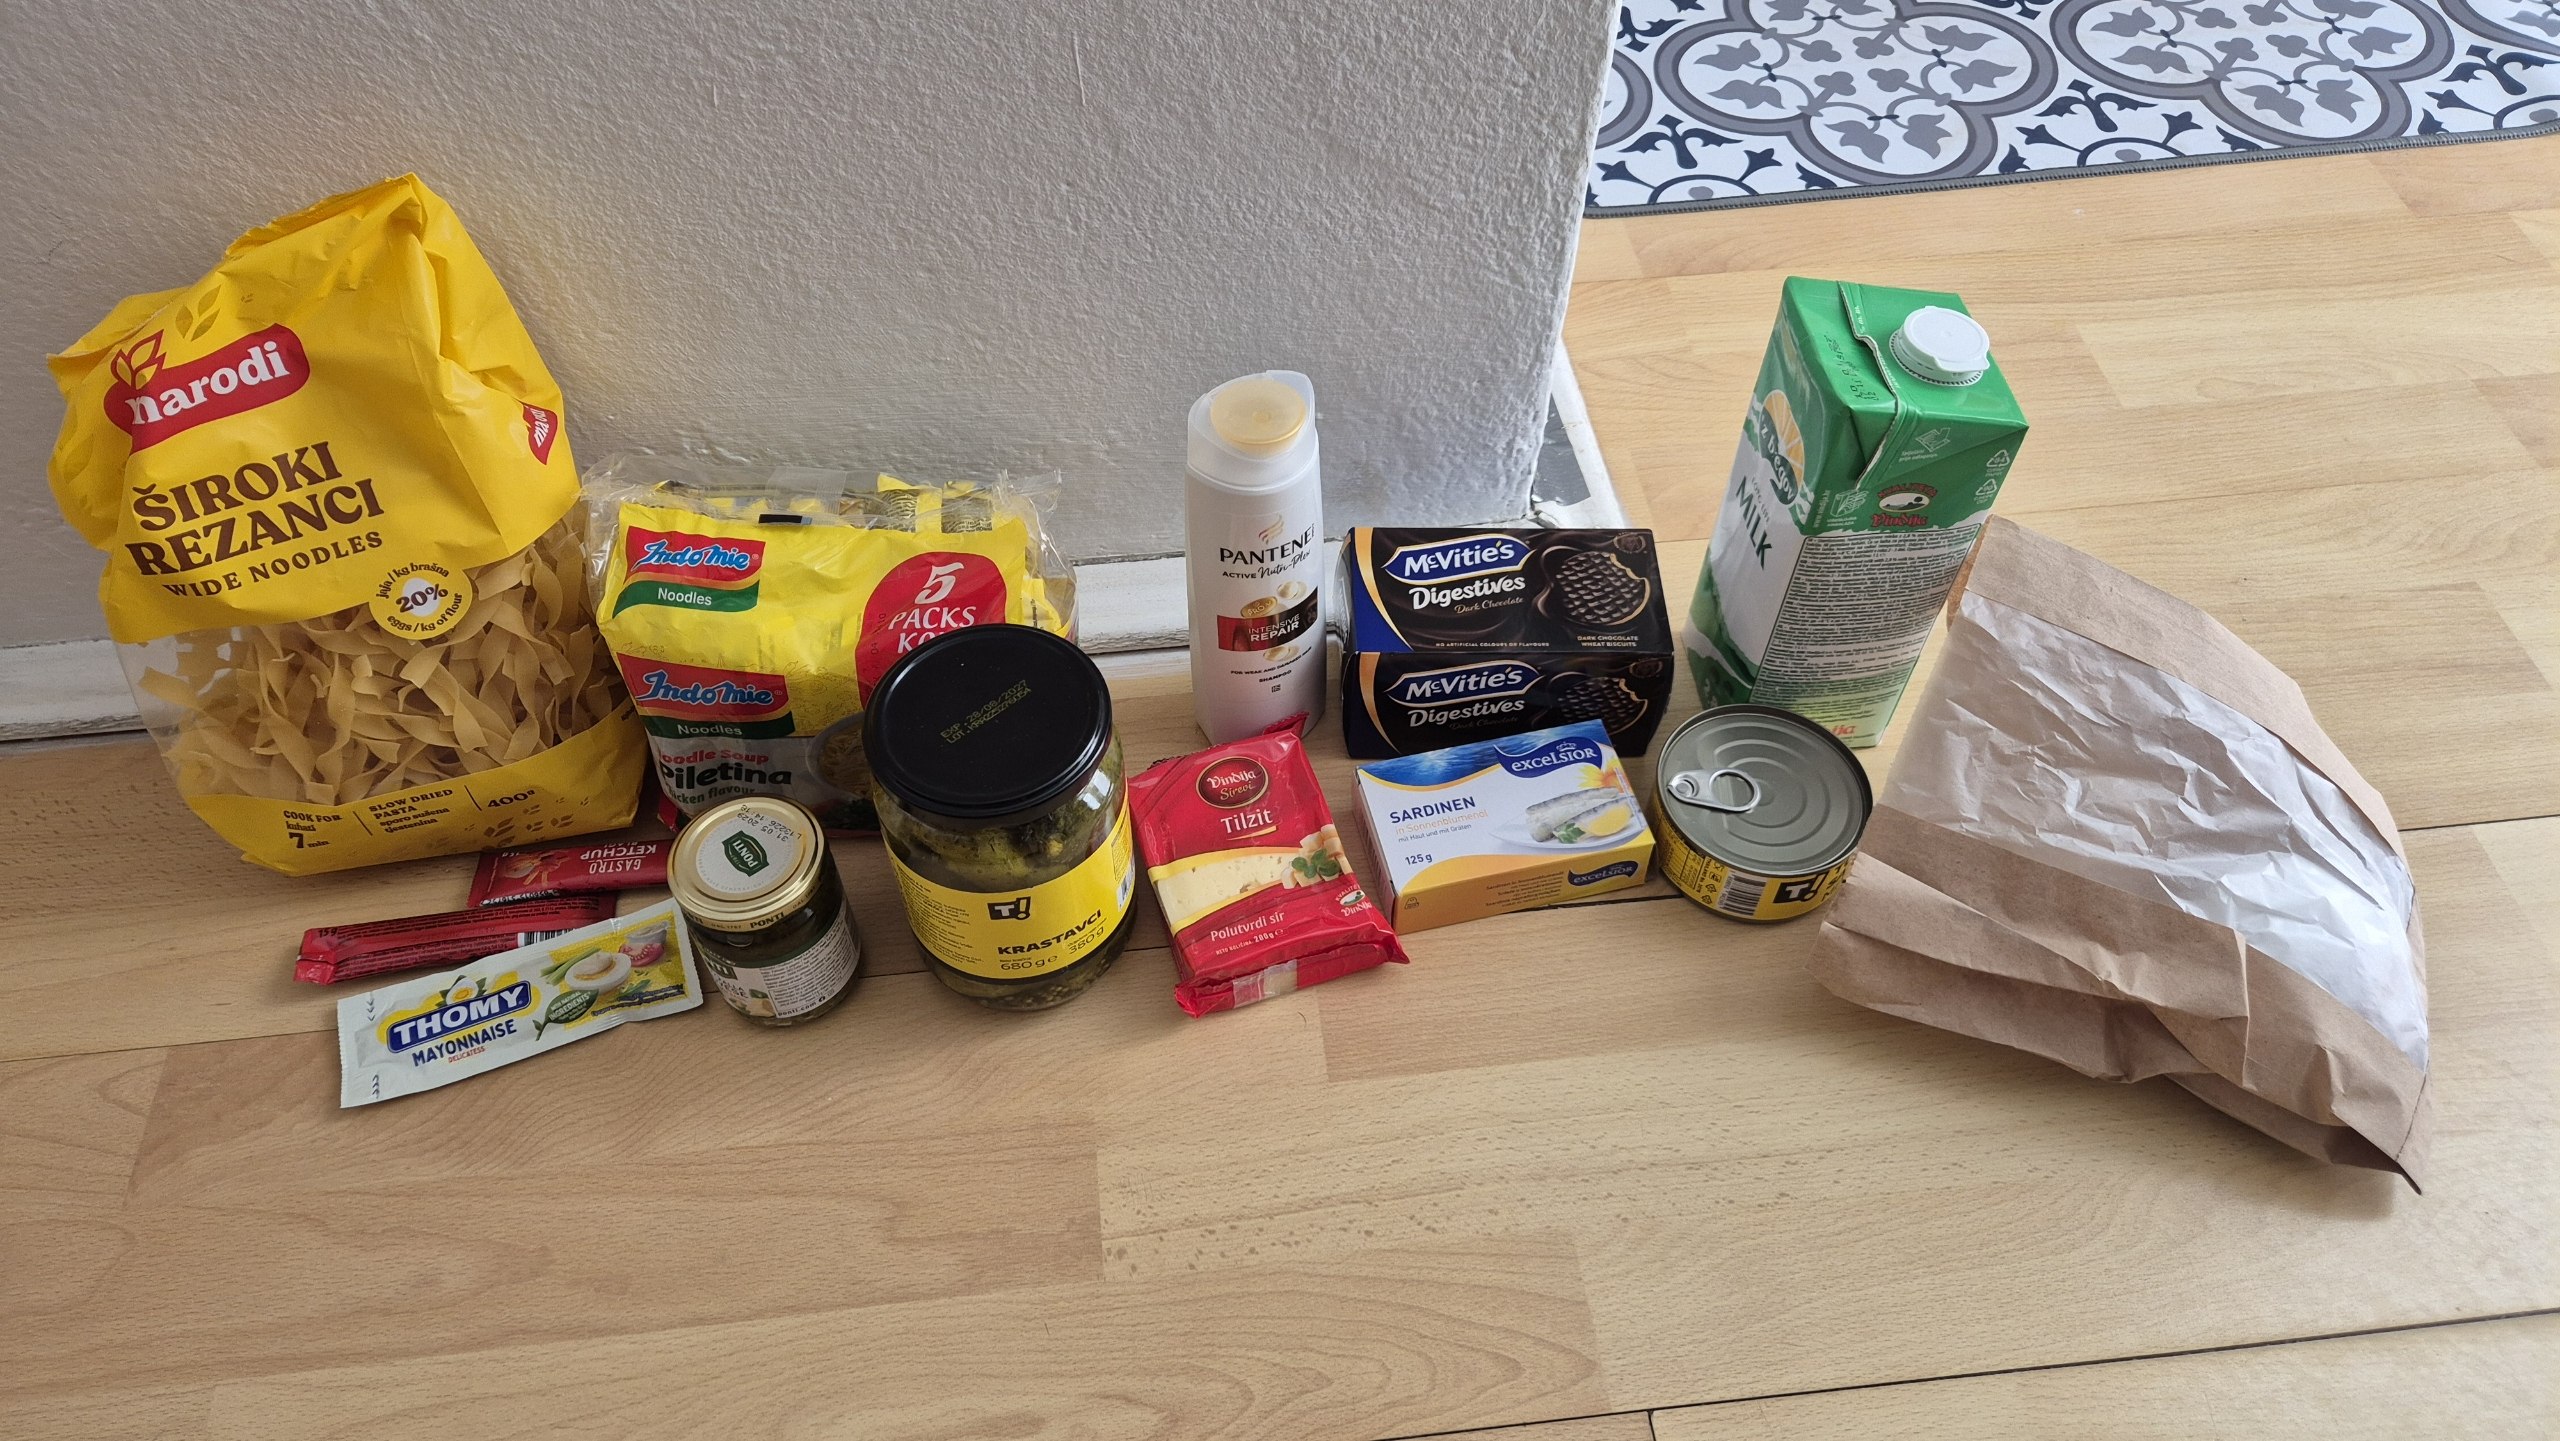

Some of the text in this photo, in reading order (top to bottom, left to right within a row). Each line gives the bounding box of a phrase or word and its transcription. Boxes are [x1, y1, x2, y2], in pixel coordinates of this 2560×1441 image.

[125, 341, 290, 425] narodi
[132, 441, 342, 532] ŠIROKI
[125, 478, 384, 575] REZANCI
[1736, 475, 1772, 571] MILK
[1219, 525, 1312, 565] PANTENE
[164, 530, 384, 597] WIDE NOODLES
[1404, 541, 1516, 577] McVitie's
[376, 580, 393, 599] jaja
[393, 567, 410, 579] kg
[410, 562, 450, 578] brašna
[914, 562, 965, 605] 5
[1222, 571, 1256, 579] ACTIVE
[395, 583, 449, 613] 20%
[657, 587, 713, 606] Noodles
[1408, 575, 1526, 610] Digestives
[387, 615, 412, 631] eggs
[421, 623, 436, 632] kg
[437, 614, 448, 626] of
[445, 593, 462, 617] flour
[1454, 596, 1526, 614] Dark Chocolate
[888, 606, 977, 630] PACKS
[1248, 613, 1300, 634] INTENSIVE
[1250, 621, 1300, 642] REPAIR
[1259, 669, 1292, 683] SHAMPOO
[1406, 667, 1524, 701] McVitie's
[1407, 698, 1525, 727] Digestives
[677, 723, 743, 737] Noodles
[720, 750, 769, 765] Soup
[369, 789, 454, 812] SLOW DRIED
[1220, 784, 1254, 801] Sirevi
[283, 810, 343, 823] COOK FOR
[373, 805, 418, 819] PASTA
[380, 806, 451, 827] sporo sušena
[1220, 808, 1274, 834] Tilzit
[1389, 796, 1476, 824] SARDINEN
[384, 817, 438, 833] tjestenina
[1396, 826, 1405, 836] in
[288, 832, 330, 849] 7 min
[1410, 833, 1425, 841] Haut
[580, 845, 657, 860] KETCHUP
[733, 840, 759, 868] PONTI
[1404, 853, 1433, 865] 125 g
[589, 859, 642, 875] GASTRO
[749, 912, 785, 929] PONTI
[998, 909, 1102, 955] KRASTAVCI
[1210, 911, 1286, 942] Polutvrdi sir
[1069, 935, 1095, 955] 380
[1096, 926, 1104, 937] g
[1215, 948, 1228, 956] NETO
[1001, 961, 1032, 971] 680
[1035, 959, 1045, 968] g
[392, 985, 526, 1046] THOMY
[412, 1018, 517, 1067] MAYONNAISE
[448, 1047, 486, 1064] DELICATESS
